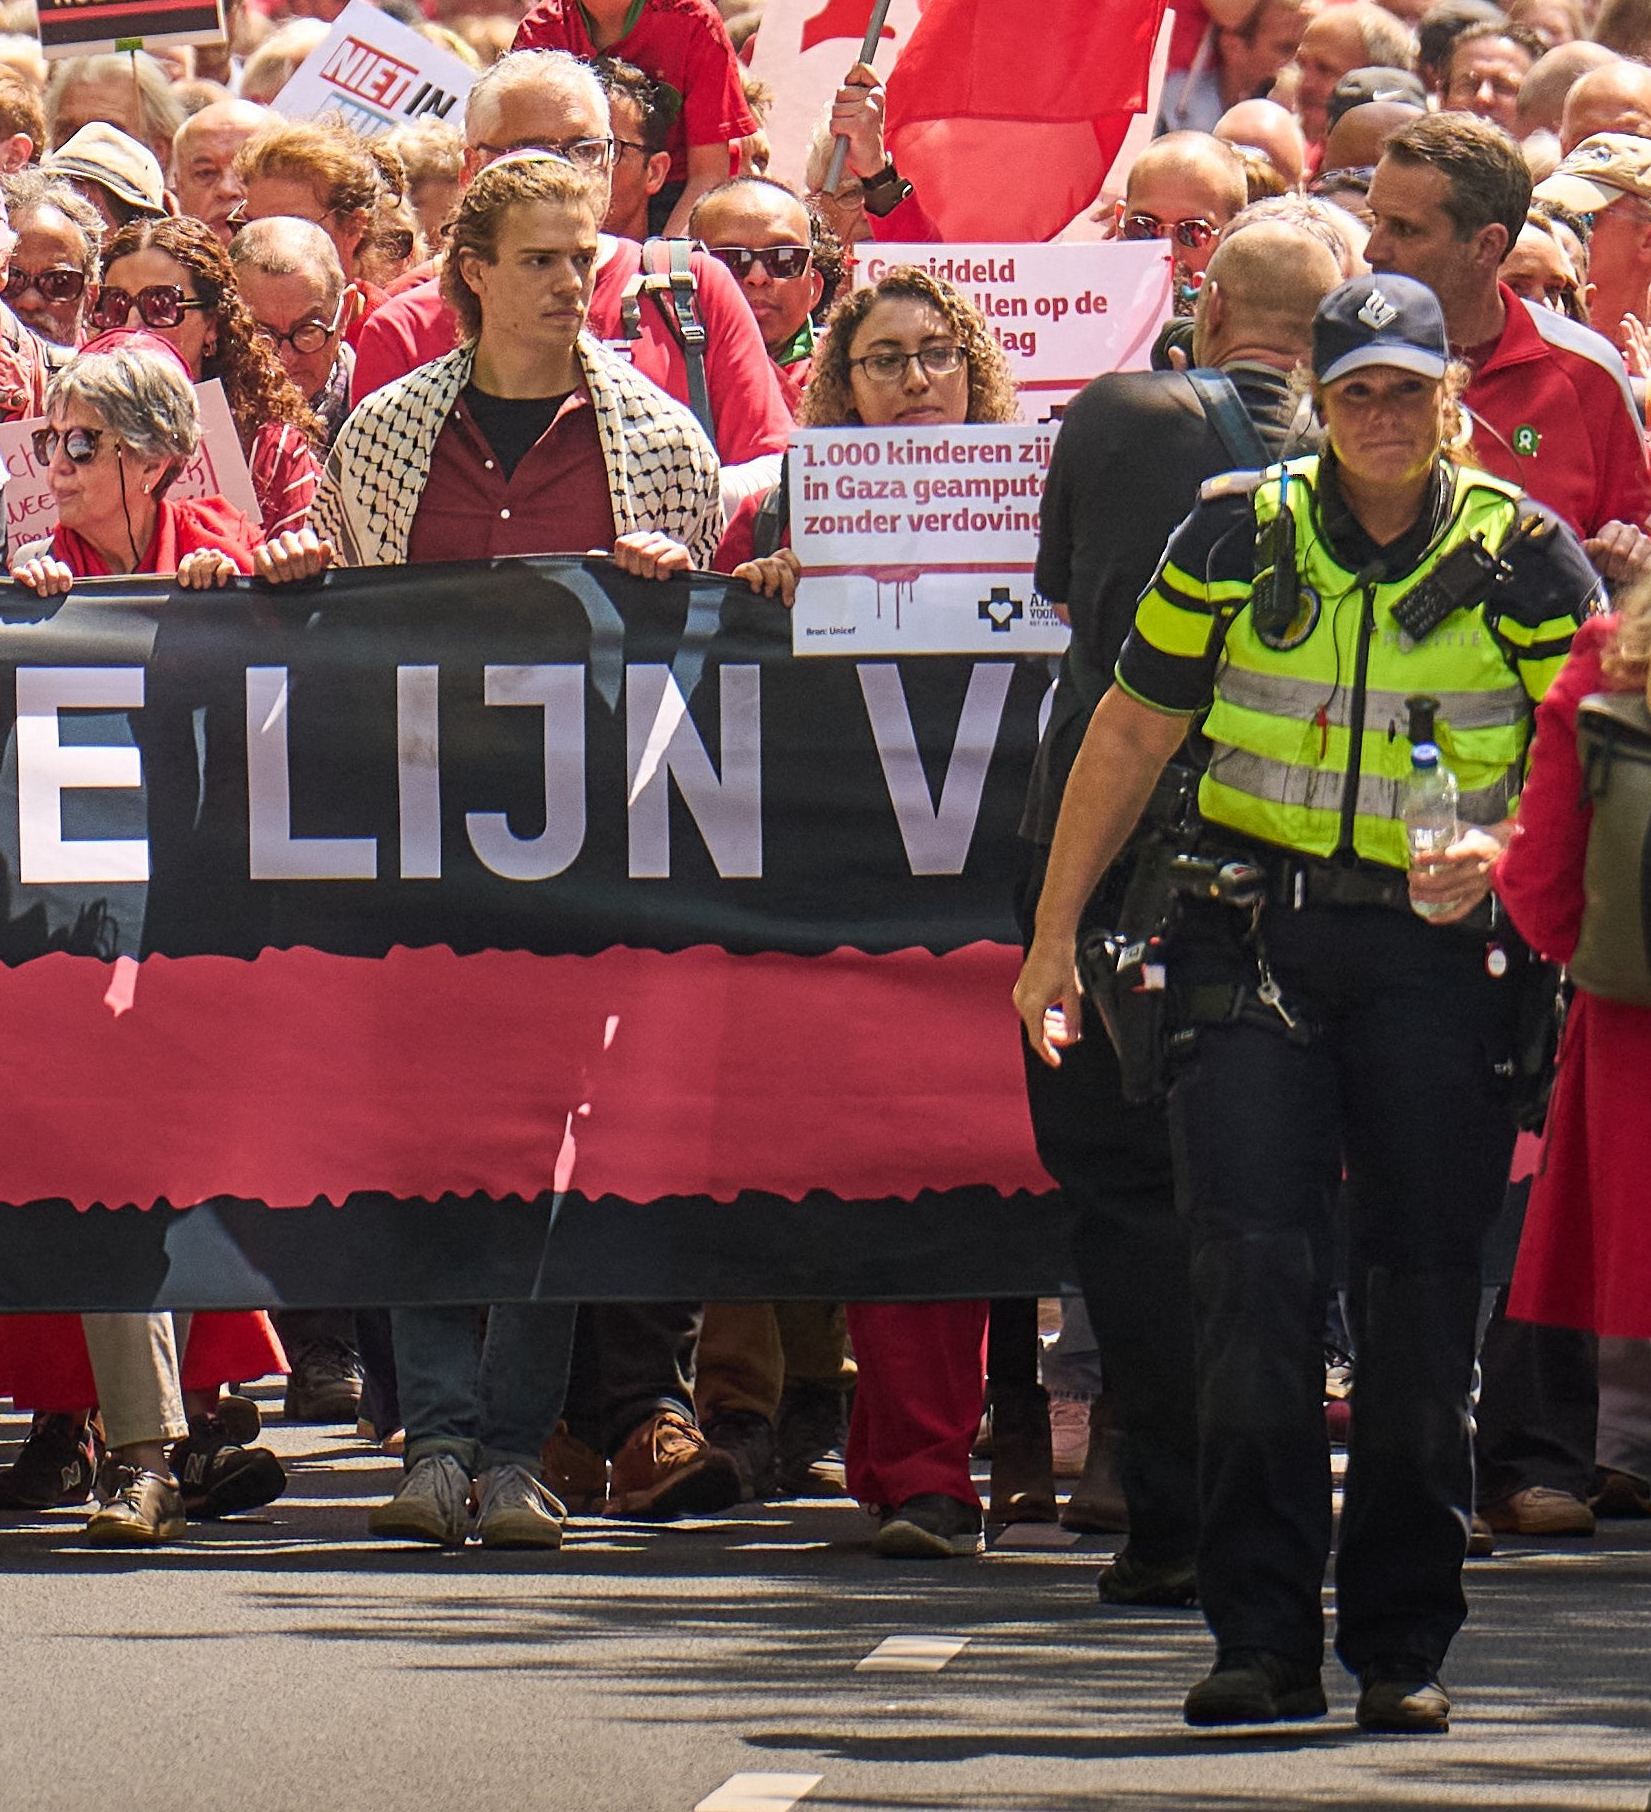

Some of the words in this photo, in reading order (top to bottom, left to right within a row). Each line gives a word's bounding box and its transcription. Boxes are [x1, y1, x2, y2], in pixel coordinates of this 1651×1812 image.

[321, 39, 413, 107] NIET
[403, 80, 459, 120] IN
[1034, 295, 1069, 322] op
[1074, 290, 1108, 315] de
[994, 327, 1037, 358] ag
[803, 442, 880, 467] 1.000
[887, 438, 1012, 467] kinderen
[1018, 436, 1052, 470] zij
[803, 474, 830, 501] in
[836, 474, 908, 501] Gaza
[803, 509, 899, 536] zonder
[829, 625, 857, 637] Unicef
[1383, 629, 1482, 650] PITIE
[246, 663, 763, 881] LIJN
